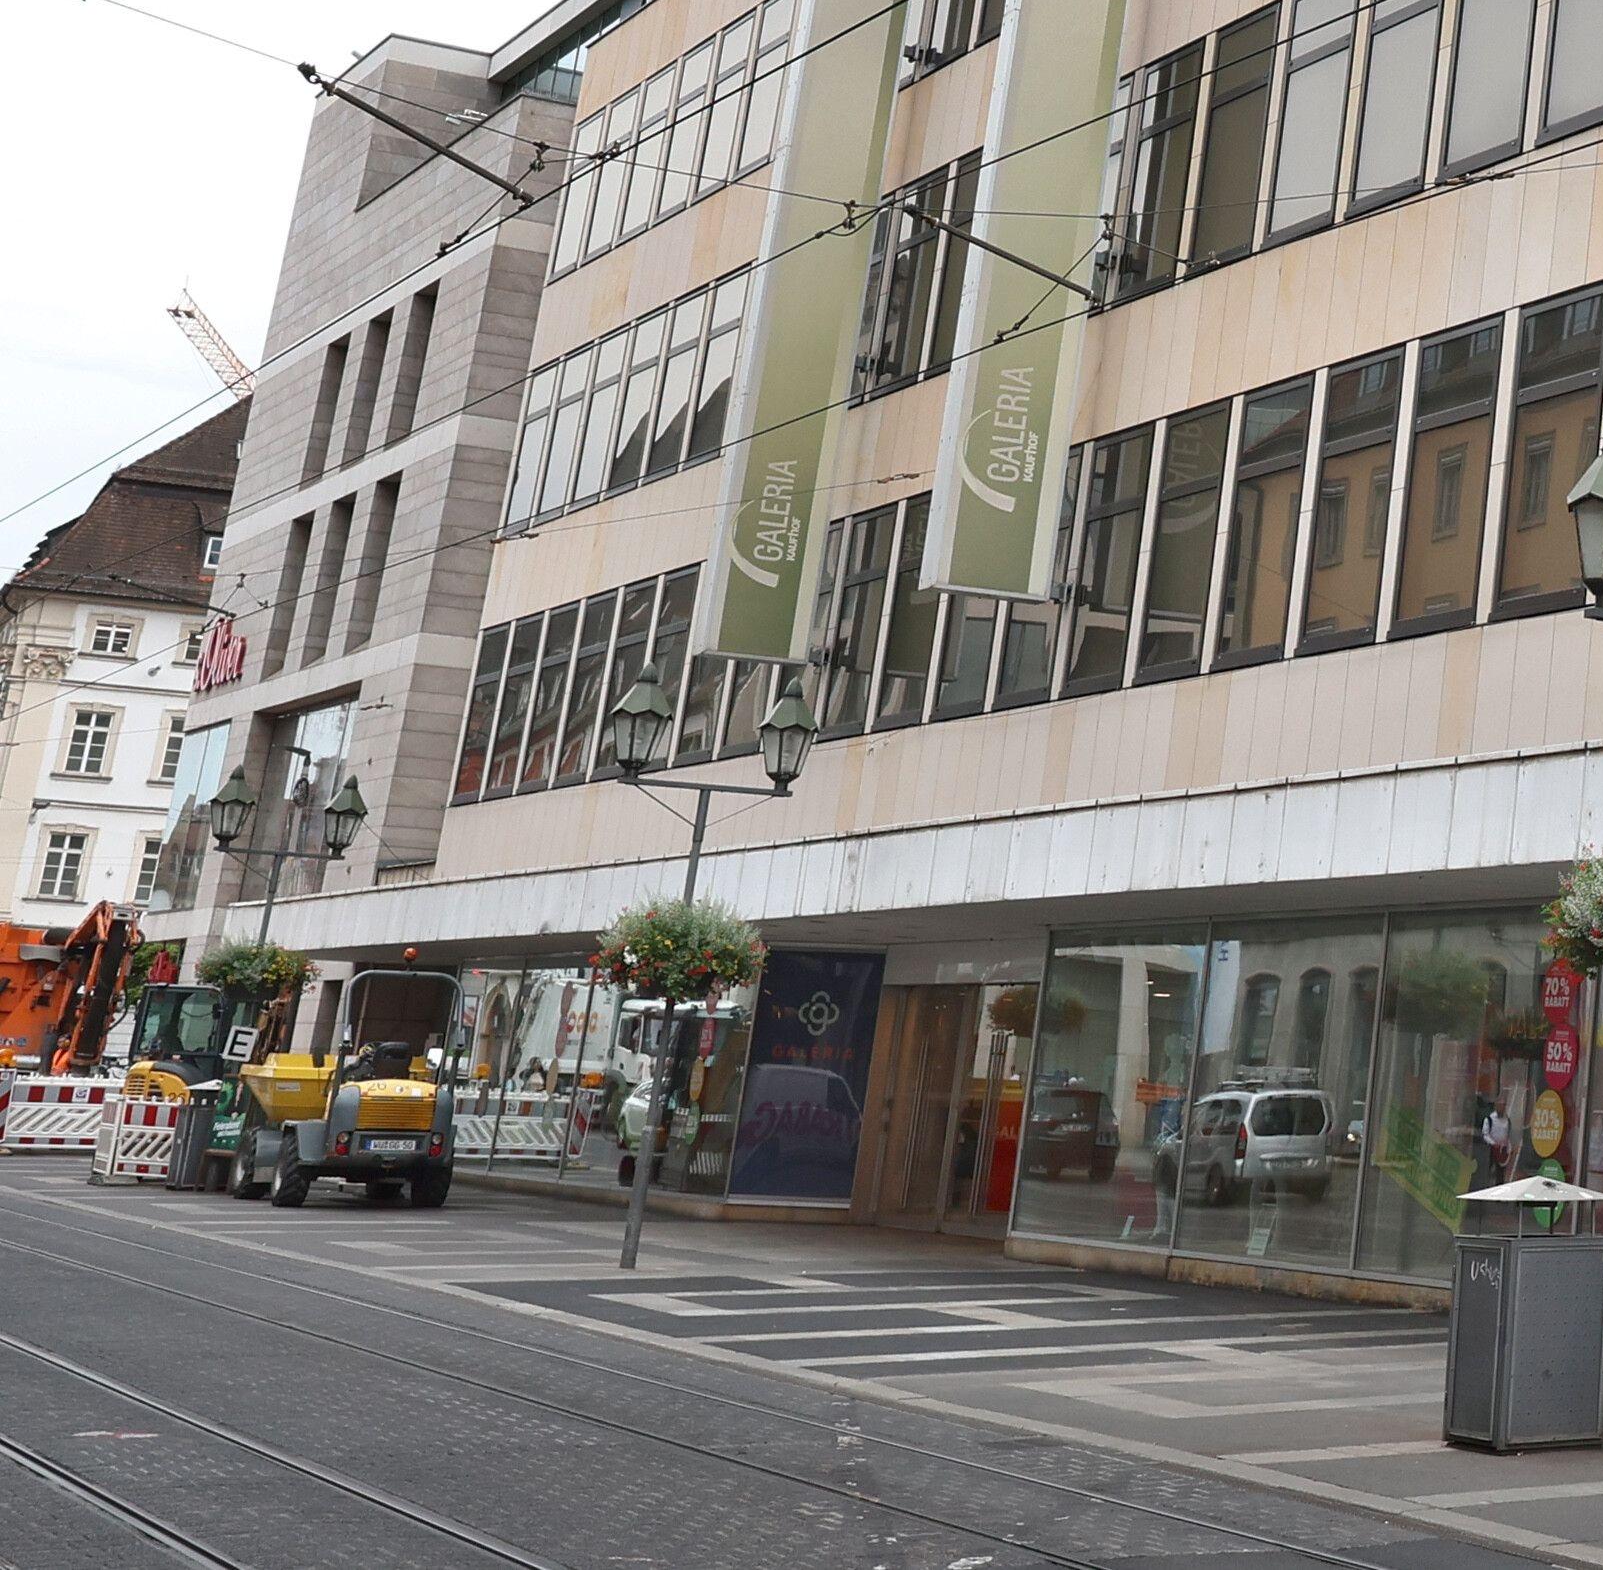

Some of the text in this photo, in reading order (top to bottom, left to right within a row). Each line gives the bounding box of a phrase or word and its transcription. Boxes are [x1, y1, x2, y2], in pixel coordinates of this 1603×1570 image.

[987, 365, 1035, 485] GALERIA
[754, 459, 798, 564] GALERIA
[1544, 996, 1570, 1007] RABATT
[227, 1029, 254, 1057] E
[1546, 1062, 1572, 1074] RABATT
[1533, 1130, 1559, 1142] RABATT
